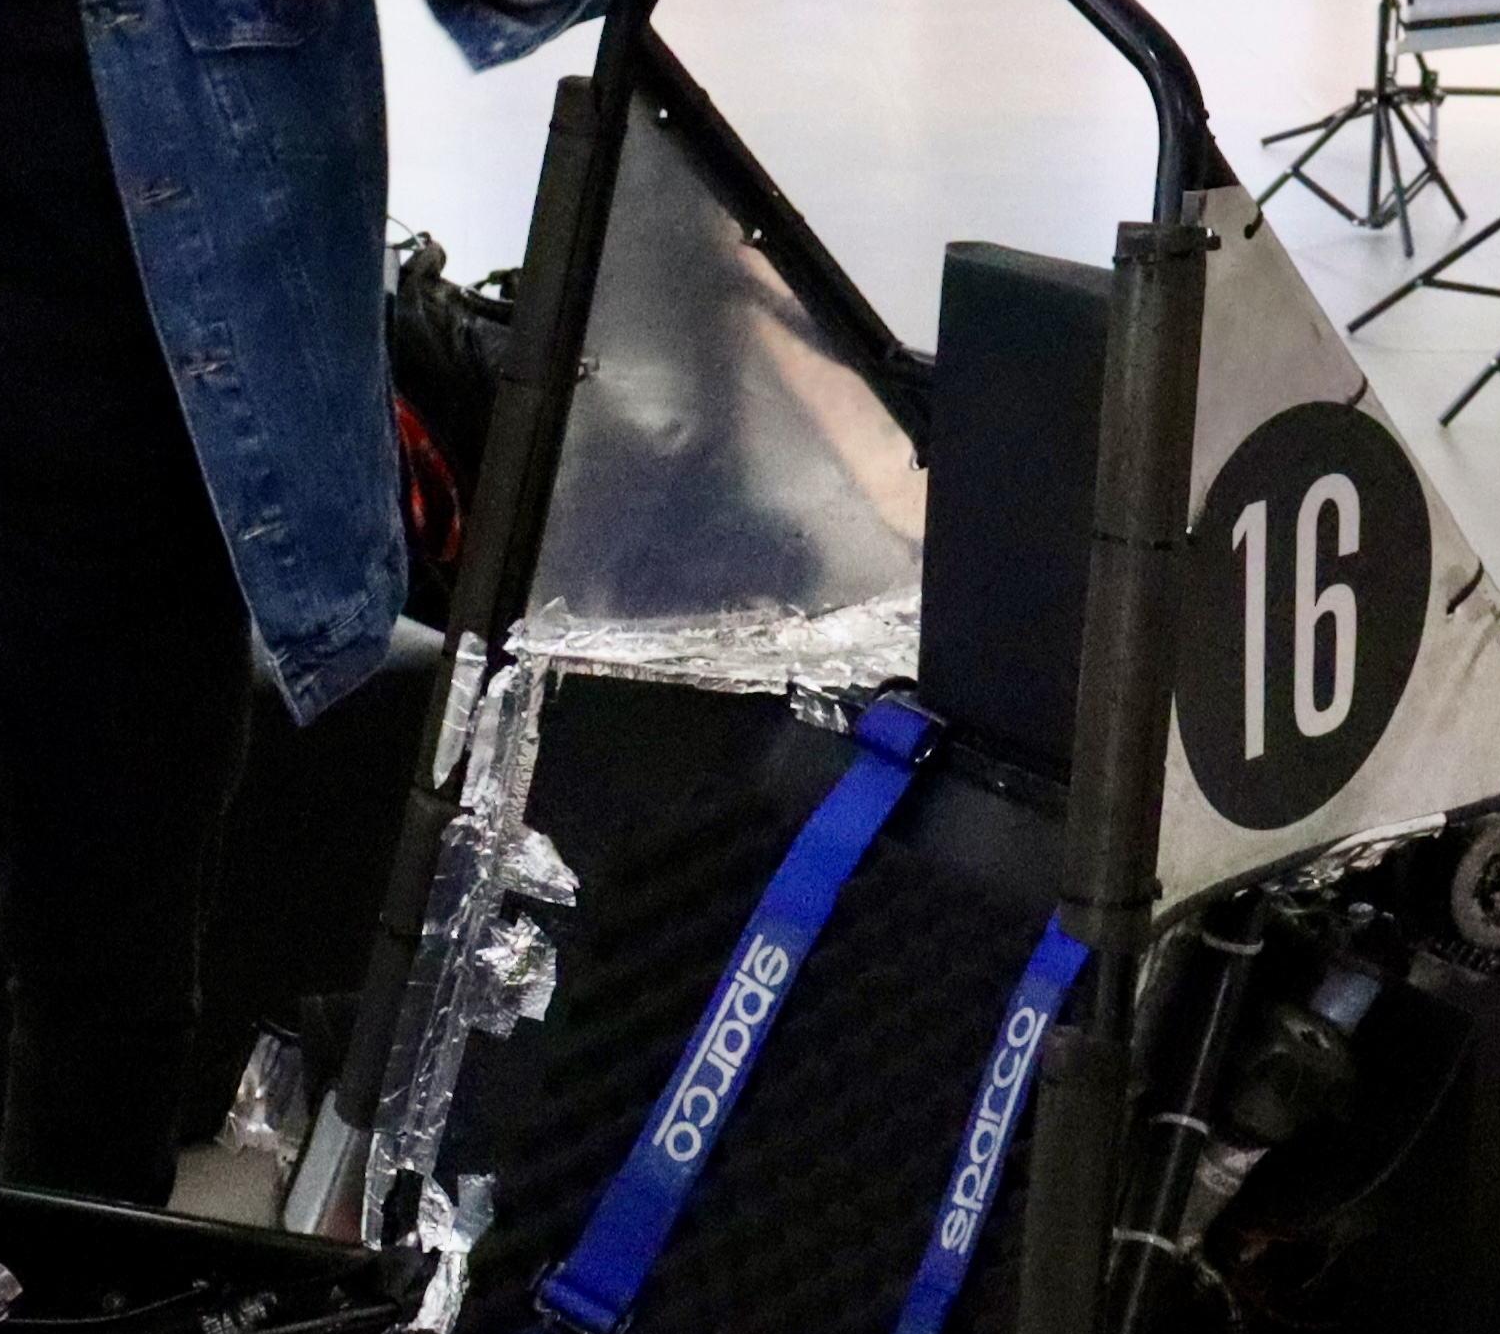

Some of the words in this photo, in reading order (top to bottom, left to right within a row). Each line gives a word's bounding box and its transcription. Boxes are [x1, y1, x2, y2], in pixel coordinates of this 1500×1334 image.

[1231, 472, 1364, 760] 16
[653, 933, 790, 1162] sparco
[941, 1005, 1047, 1256] sparco
